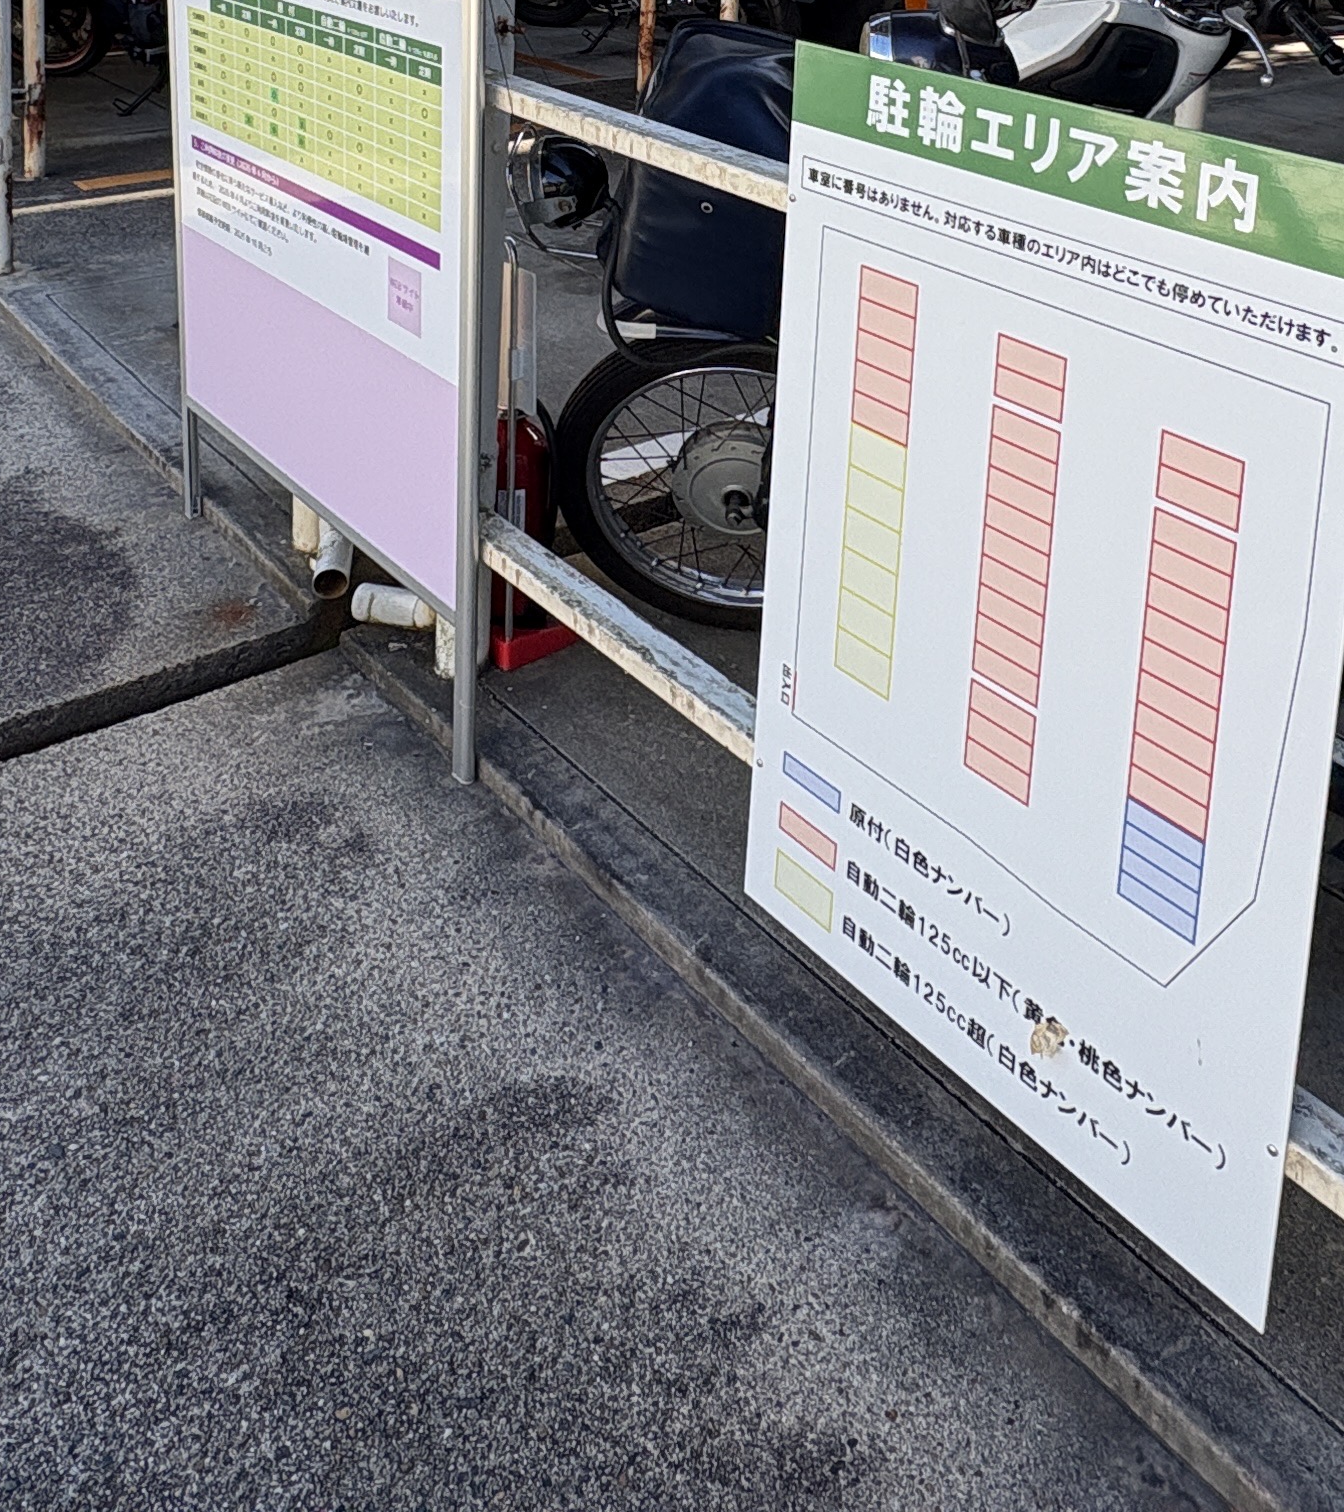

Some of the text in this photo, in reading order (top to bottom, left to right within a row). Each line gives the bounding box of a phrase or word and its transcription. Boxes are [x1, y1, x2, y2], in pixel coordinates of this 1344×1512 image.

[865, 73, 1262, 236] 駐輪エリア案内
[807, 165, 1343, 360] 車室に番号はありません。対応する車種のエリア内はどこでも停めていただけます。
[841, 913, 1132, 1169] 自動二輪125cc超（白色ナンバー）
